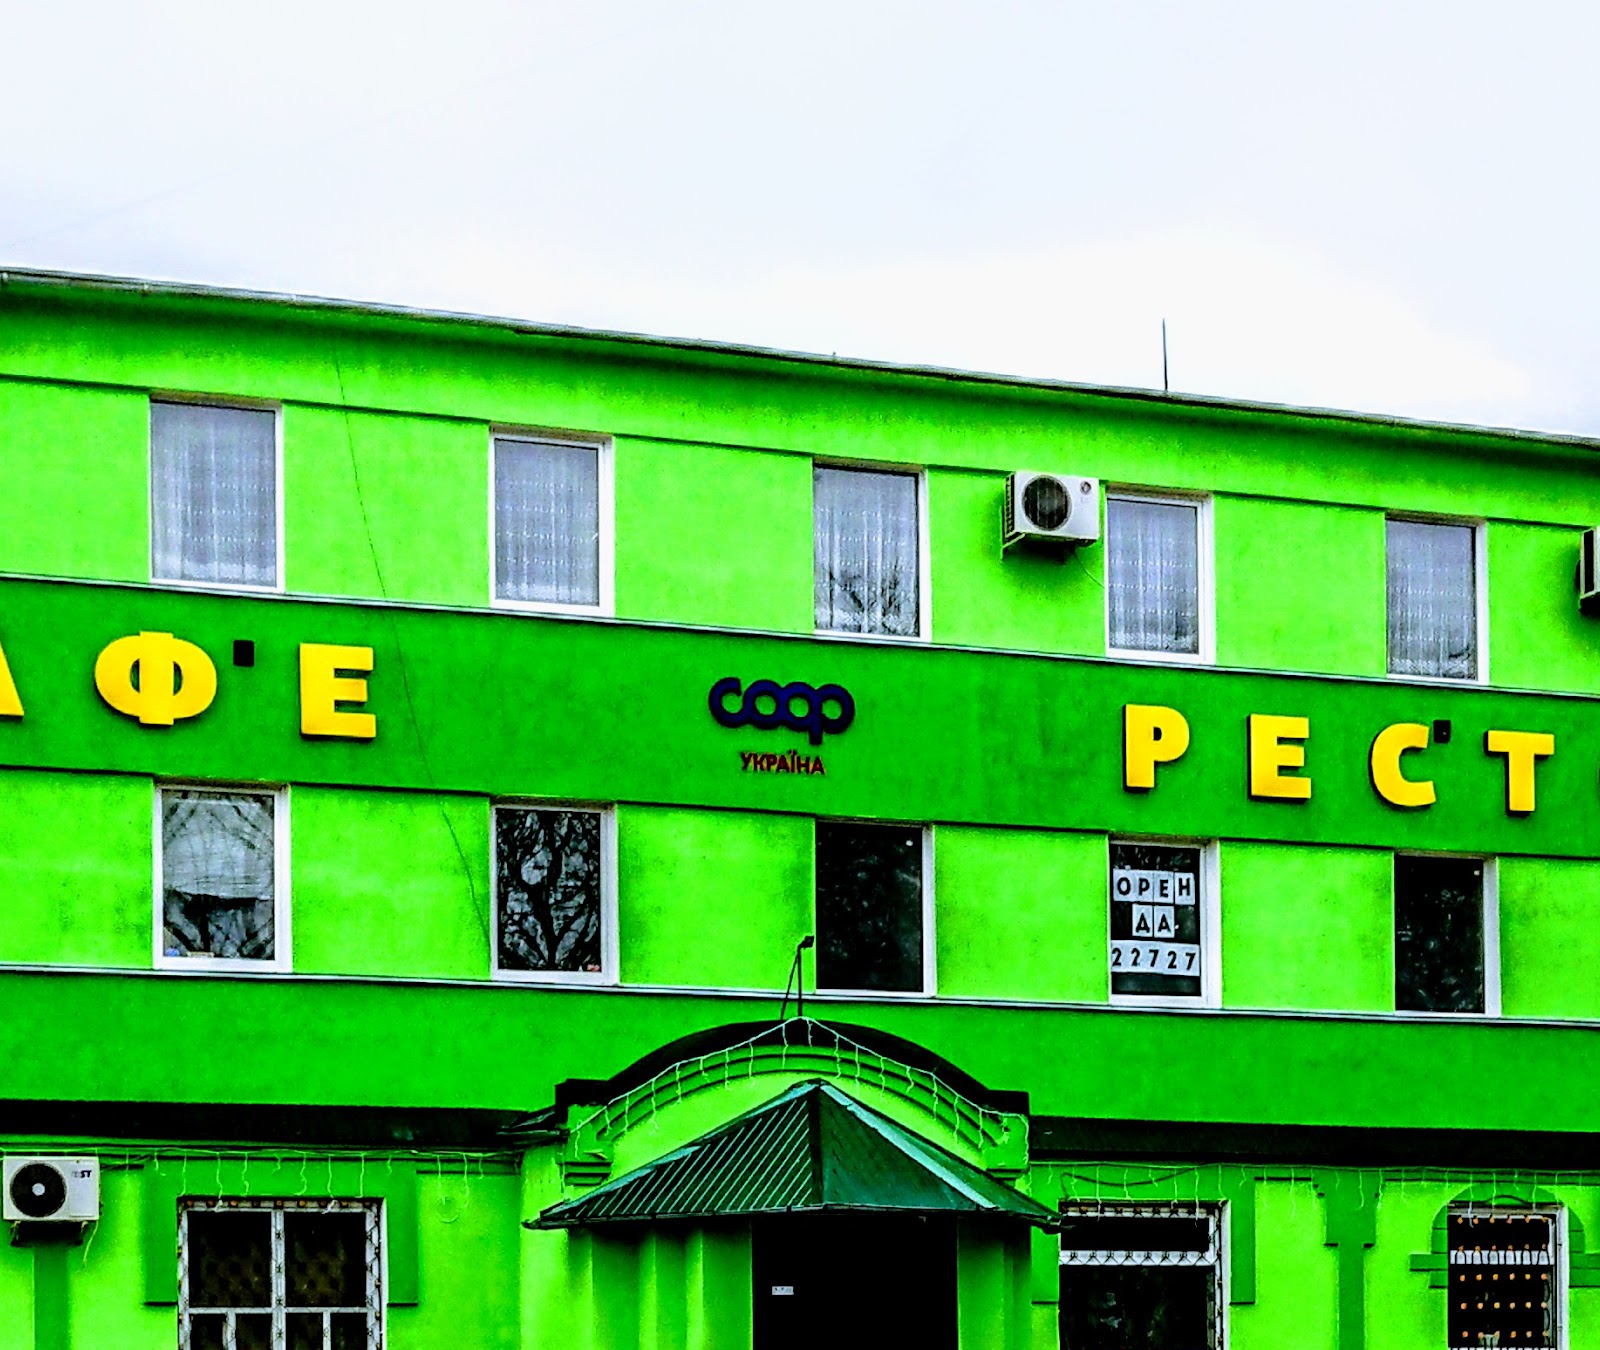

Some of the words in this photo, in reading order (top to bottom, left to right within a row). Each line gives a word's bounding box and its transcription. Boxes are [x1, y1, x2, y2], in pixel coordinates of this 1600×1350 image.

[740, 750, 826, 775] УКРАЇНА
[1116, 876, 1191, 898] ОРЕН
[1135, 912, 1172, 934] ДА
[1111, 947, 1196, 971] 22727
